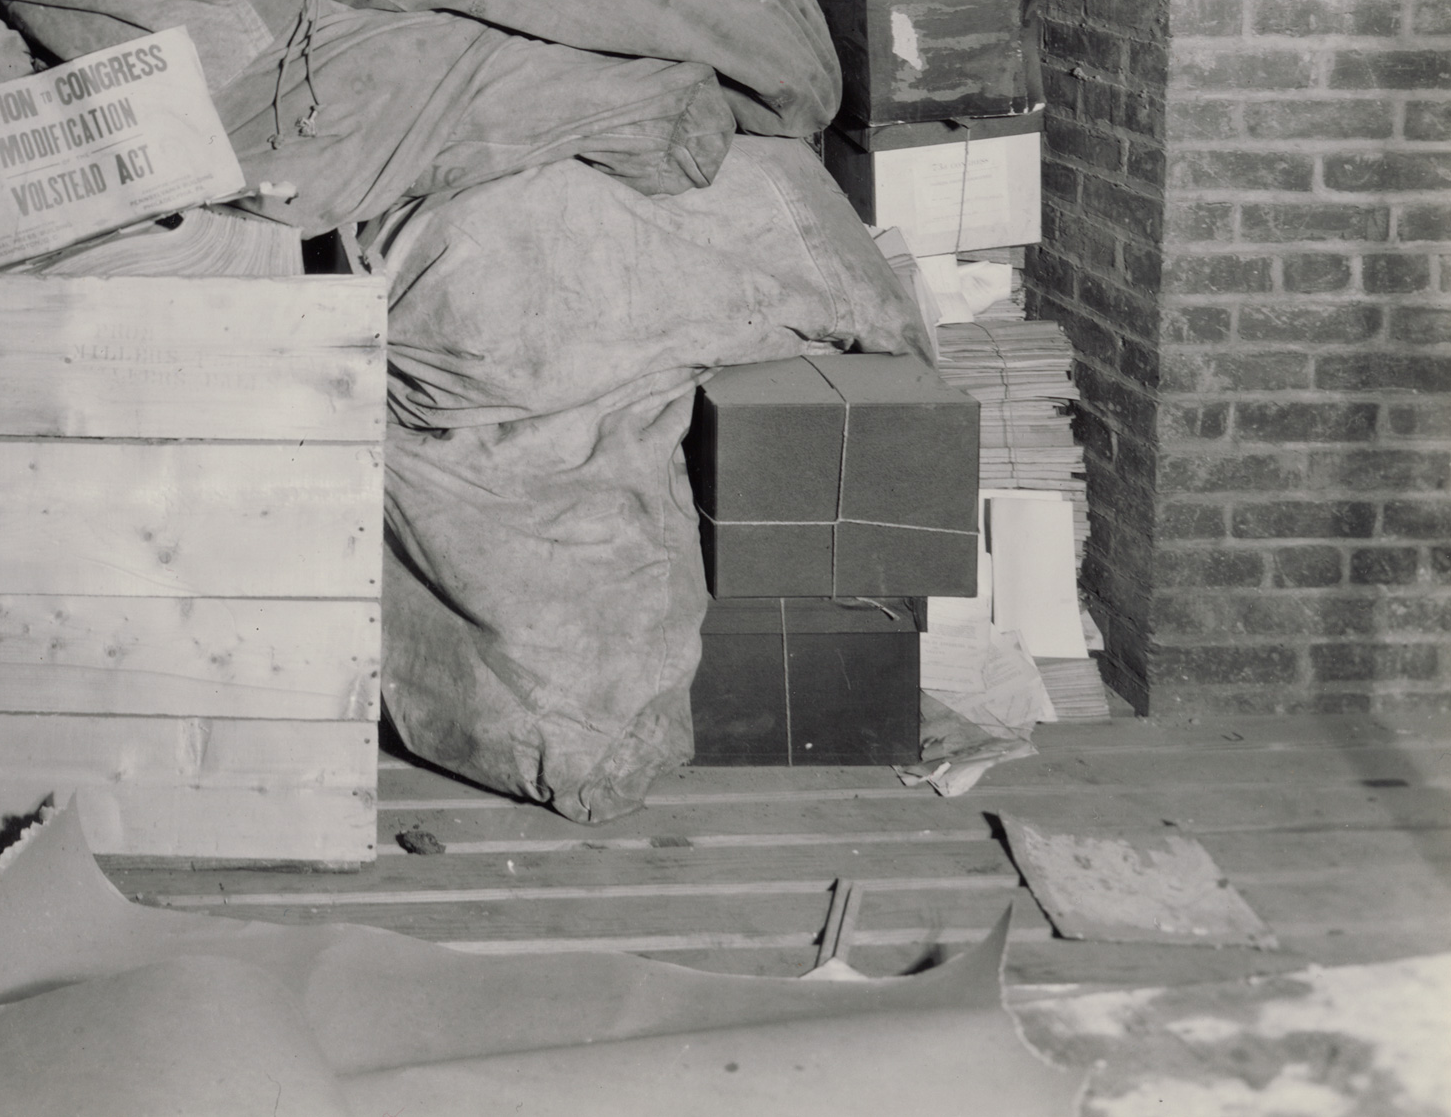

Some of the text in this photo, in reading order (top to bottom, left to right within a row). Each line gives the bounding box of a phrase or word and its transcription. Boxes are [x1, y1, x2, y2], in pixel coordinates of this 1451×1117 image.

[39, 90, 54, 105] TO
[54, 43, 168, 106] CONGRESS
[10, 162, 108, 218] VOLSTEAD
[115, 144, 155, 186] ACT
[75, 152, 91, 161] THE
